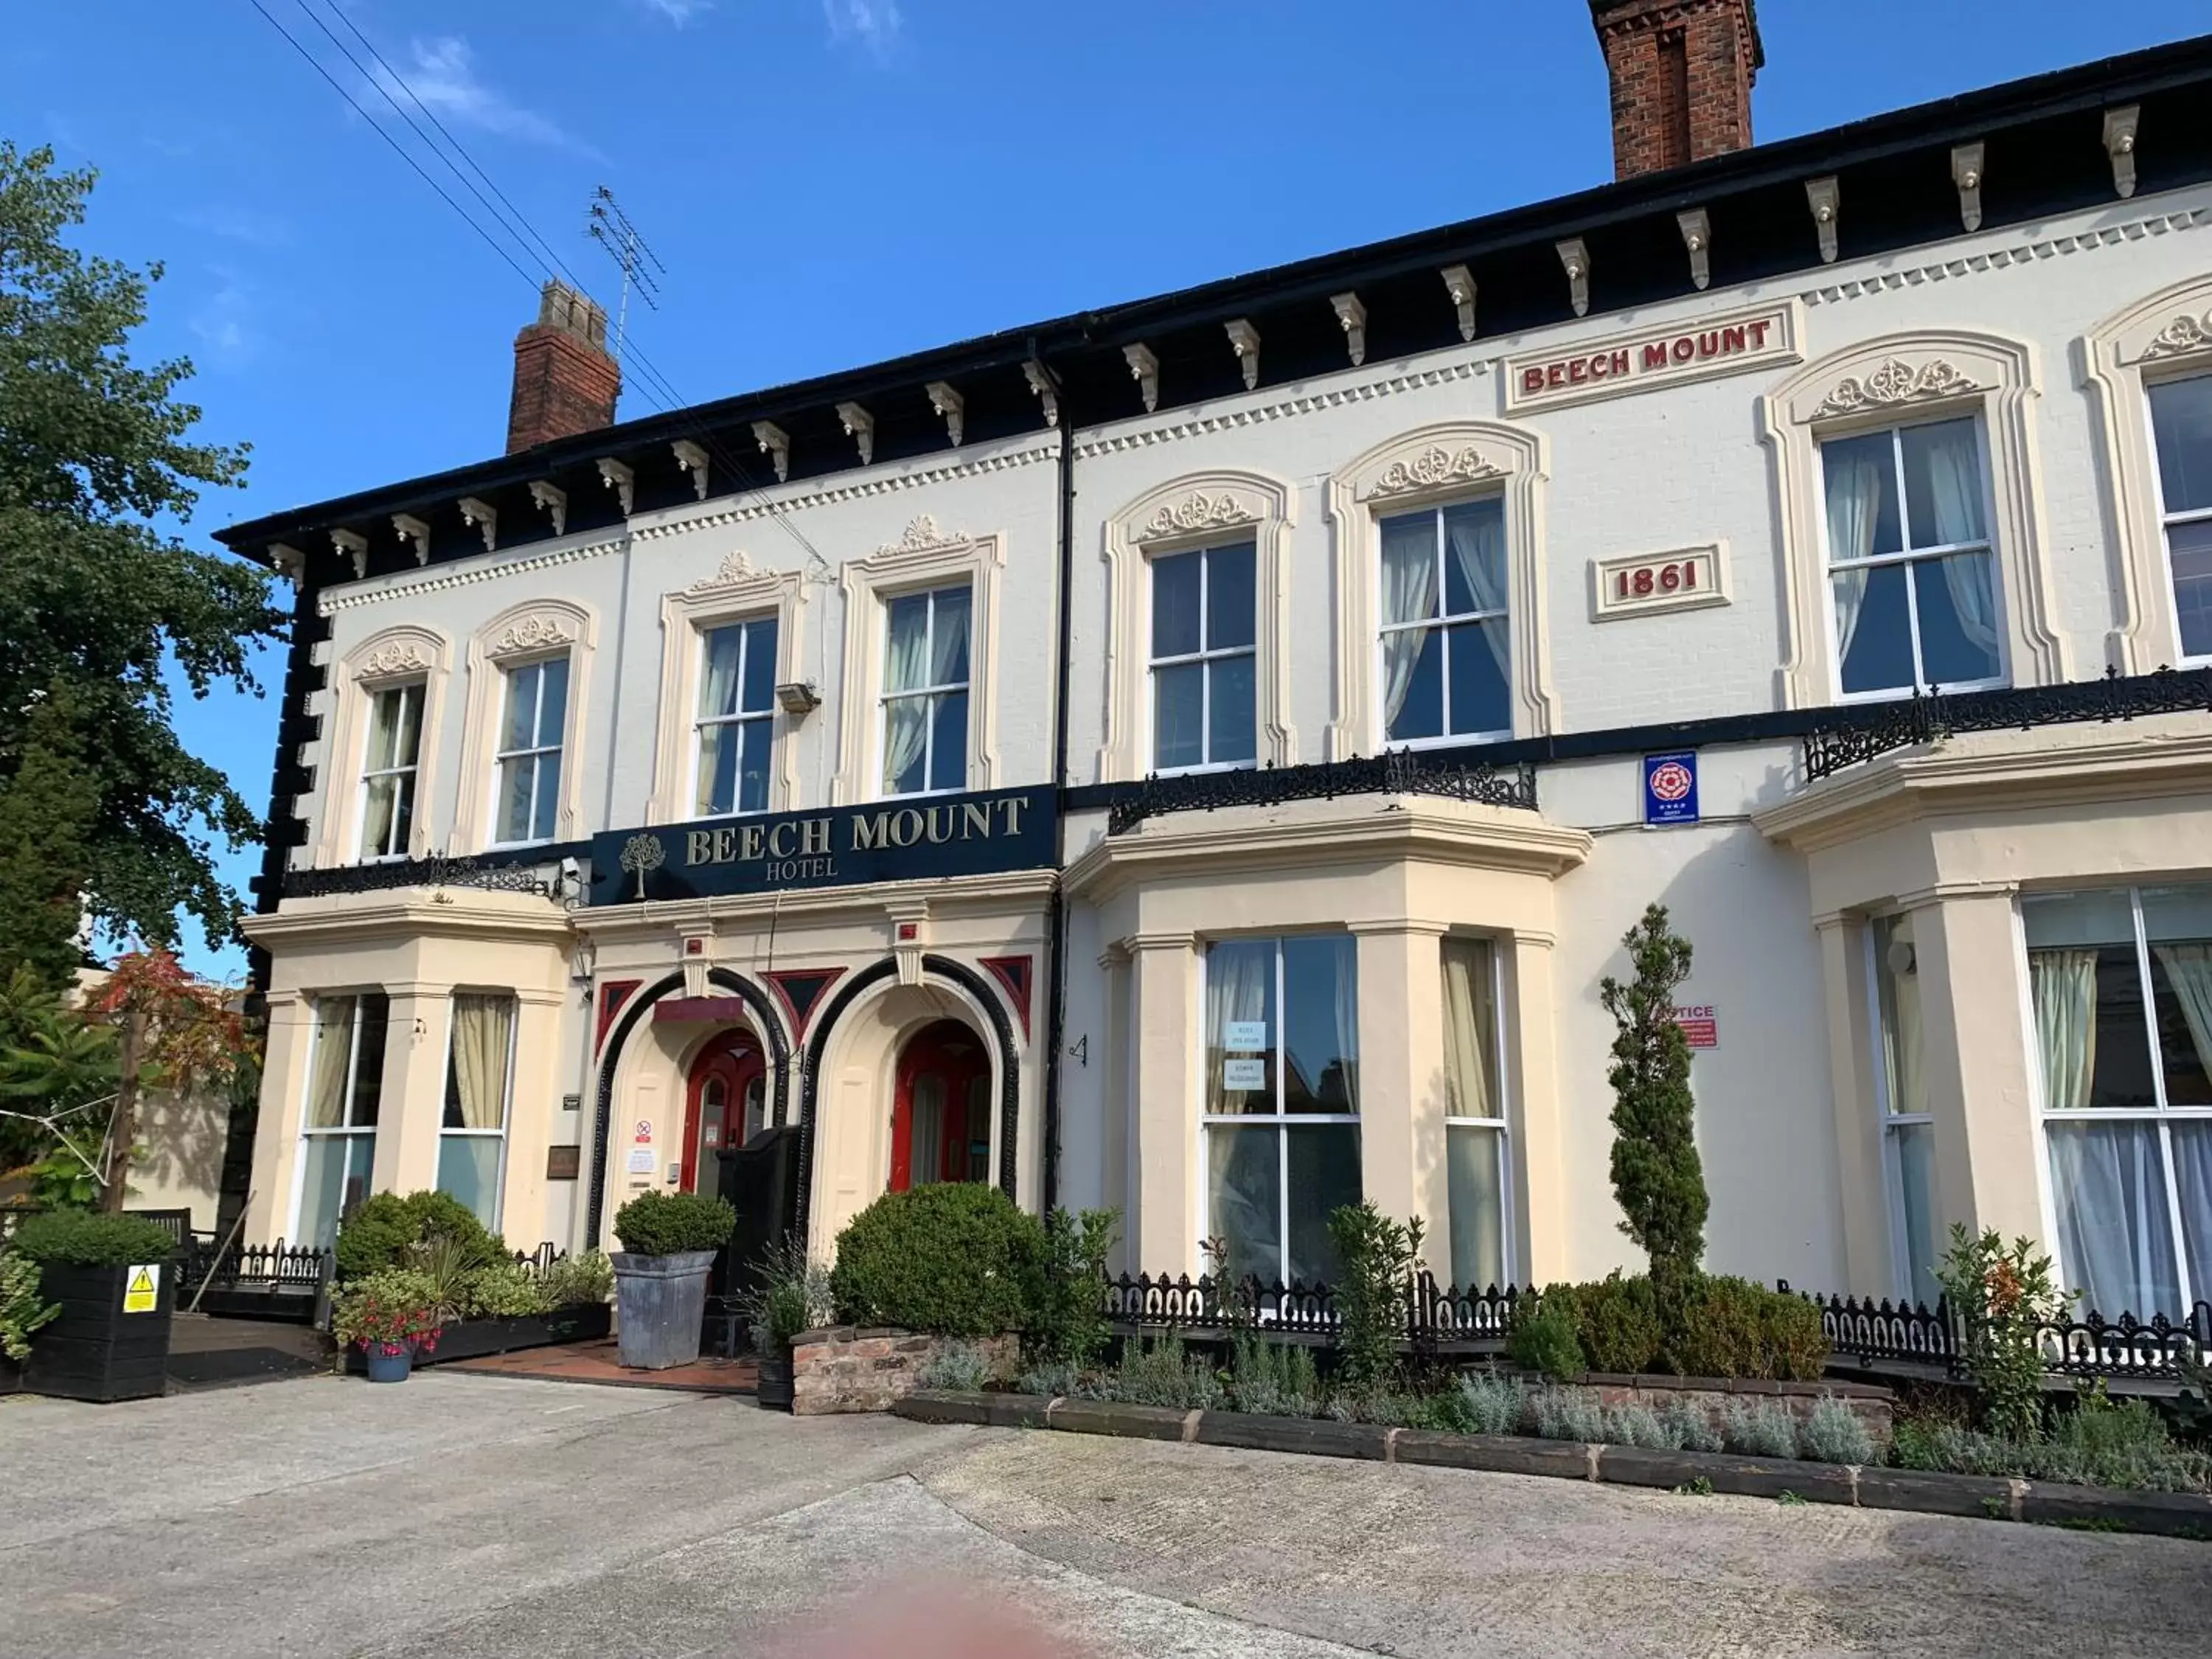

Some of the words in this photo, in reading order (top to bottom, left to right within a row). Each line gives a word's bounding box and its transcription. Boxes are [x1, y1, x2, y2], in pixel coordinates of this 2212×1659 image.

[1523, 349, 1630, 392] BEECH
[1644, 320, 1770, 368] MOUNT
[1619, 560, 1696, 596] 1861
[684, 817, 833, 866] BEECH
[849, 796, 1029, 852] MOUNT
[766, 858, 838, 882] HOTEL
